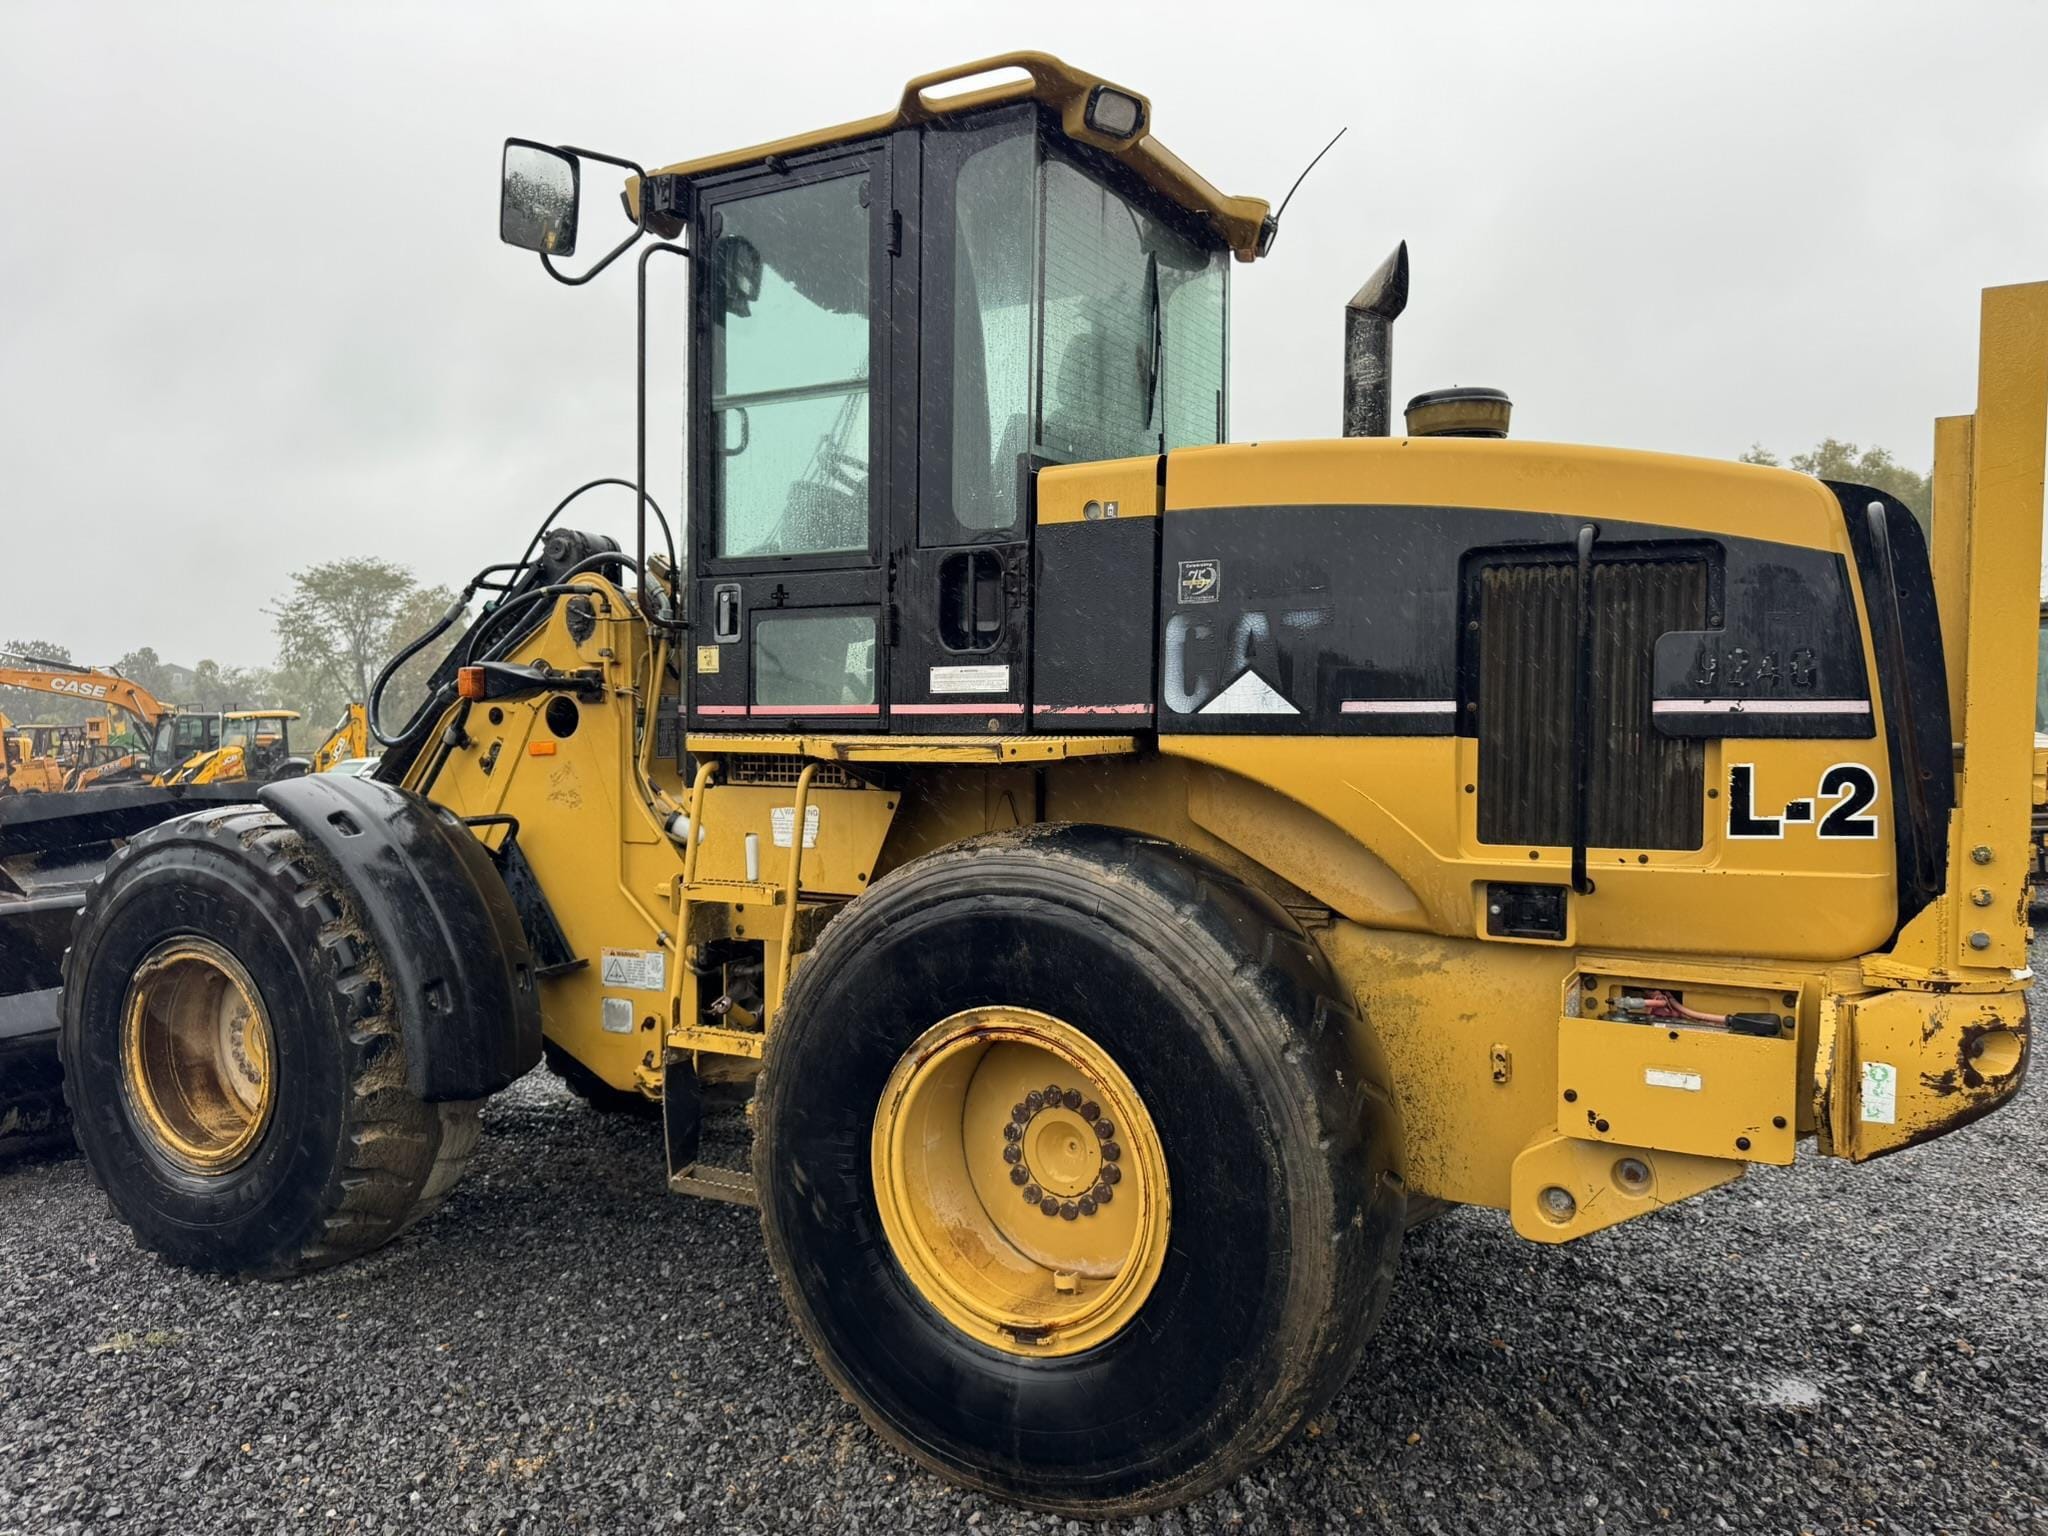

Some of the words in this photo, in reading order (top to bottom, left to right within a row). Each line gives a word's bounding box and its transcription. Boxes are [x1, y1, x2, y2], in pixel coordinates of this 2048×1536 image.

[1188, 569, 1207, 589] 75
[50, 677, 107, 698] CASE
[1727, 762, 1878, 839] L-2
